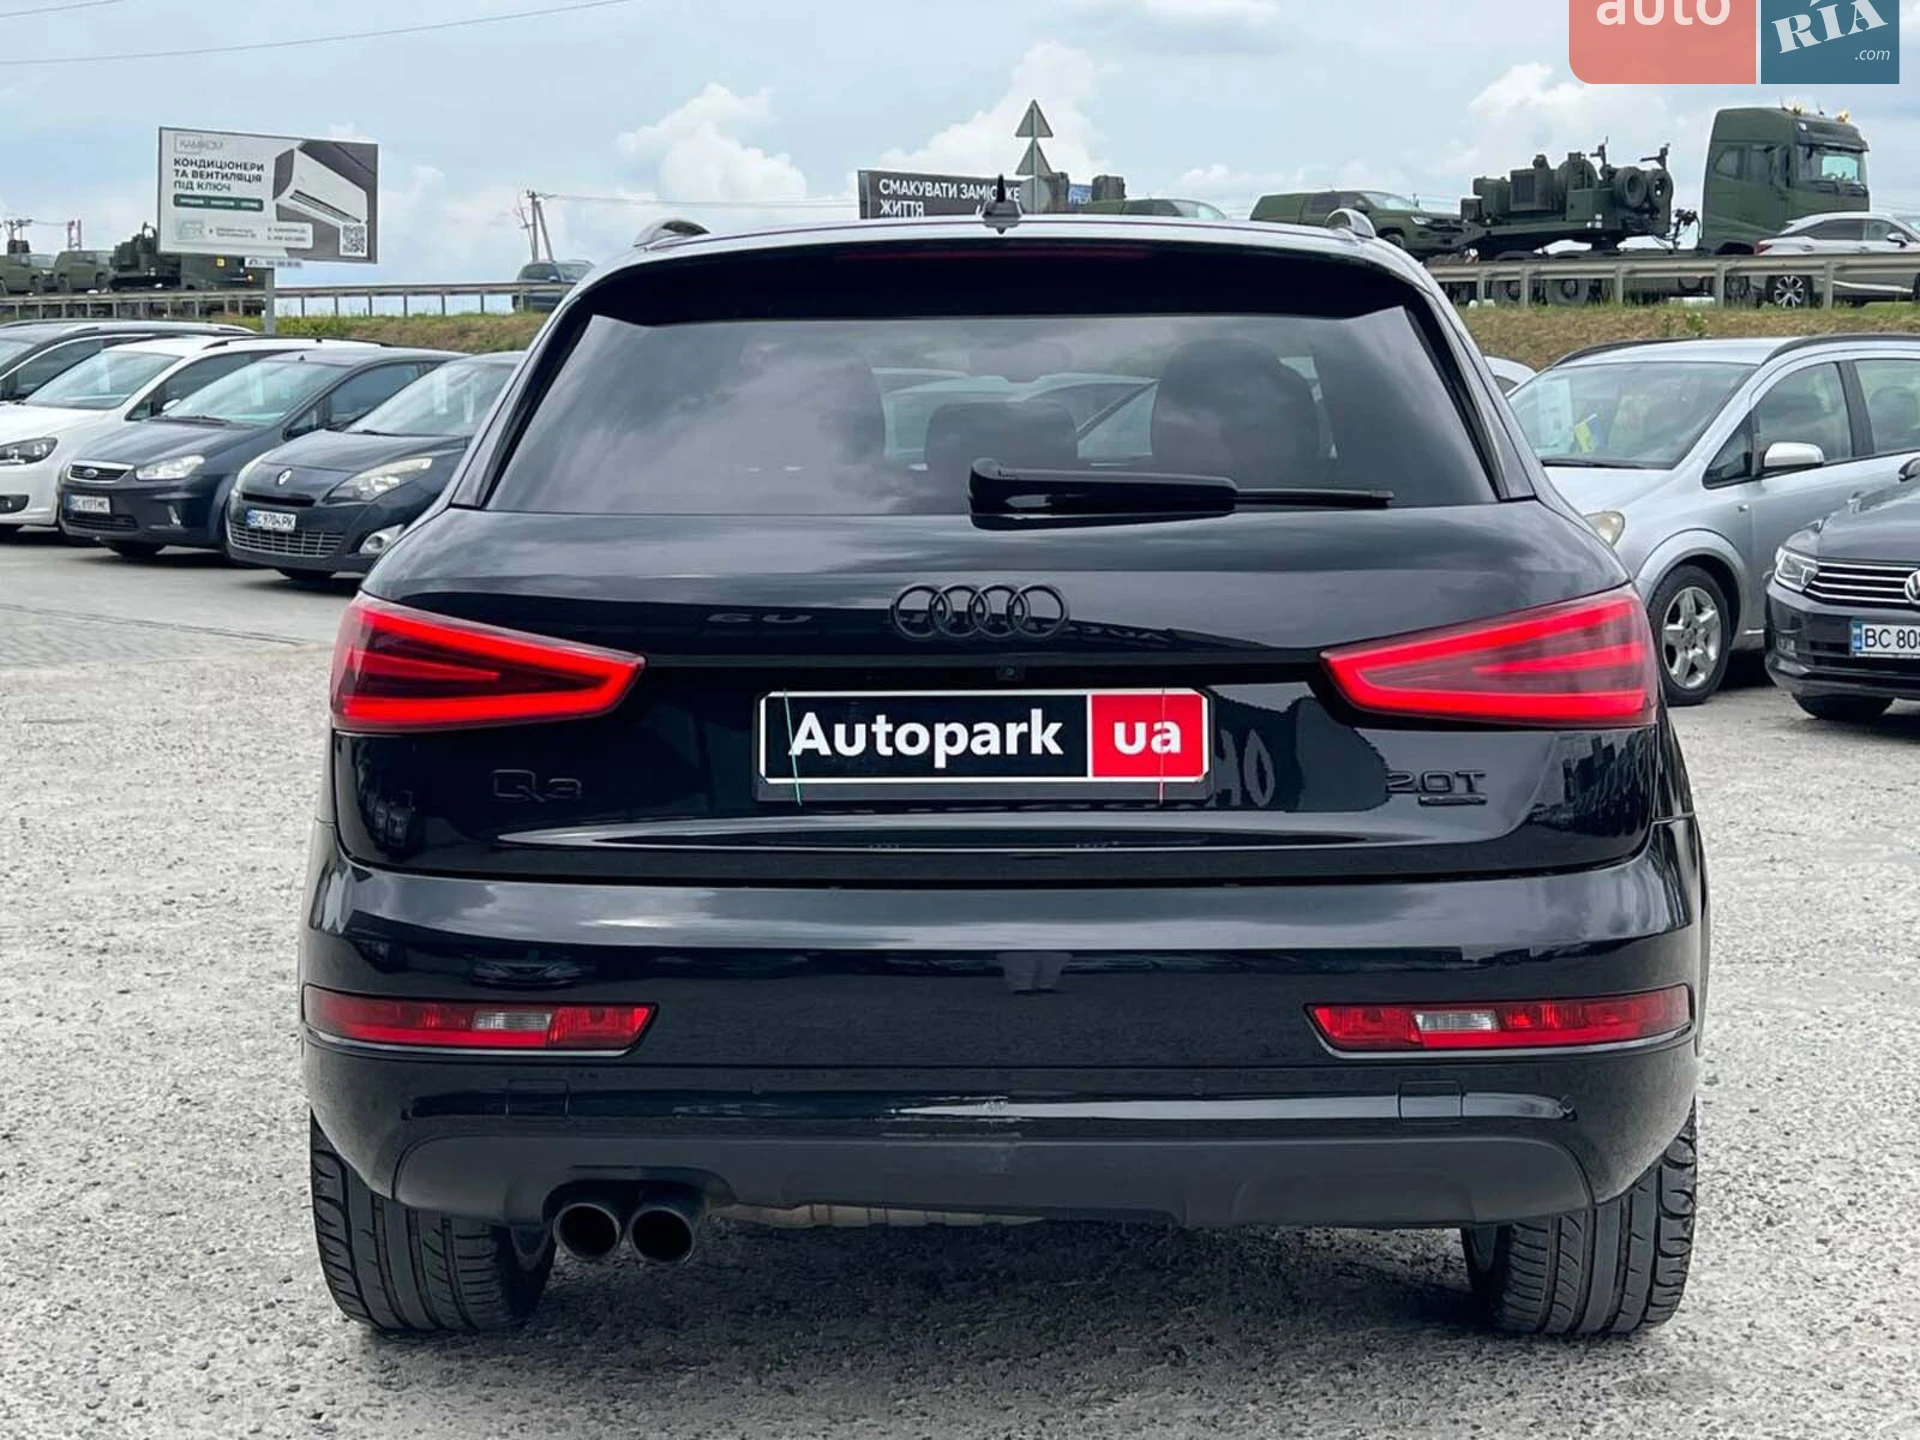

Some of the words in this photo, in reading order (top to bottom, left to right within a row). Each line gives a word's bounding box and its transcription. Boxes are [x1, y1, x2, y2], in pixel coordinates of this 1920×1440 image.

[173, 157, 265, 172] КОНДИЦІОНЕРИ
[173, 180, 194, 191] ПІД
[196, 181, 231, 192] КЛЮЧ
[174, 169, 189, 178] ТА
[191, 170, 262, 183] ВЕНТИЛЯЦІЯ
[878, 178, 958, 199] СМАКУВАТИ
[959, 182, 1021, 202] ЗАМІСКЕ
[879, 199, 925, 218] ЖИТТЯ
[1896, 629, 1920, 649] 80
[788, 707, 1064, 768] Autopark
[1112, 720, 1181, 755] ua
[492, 768, 582, 803] Q3
